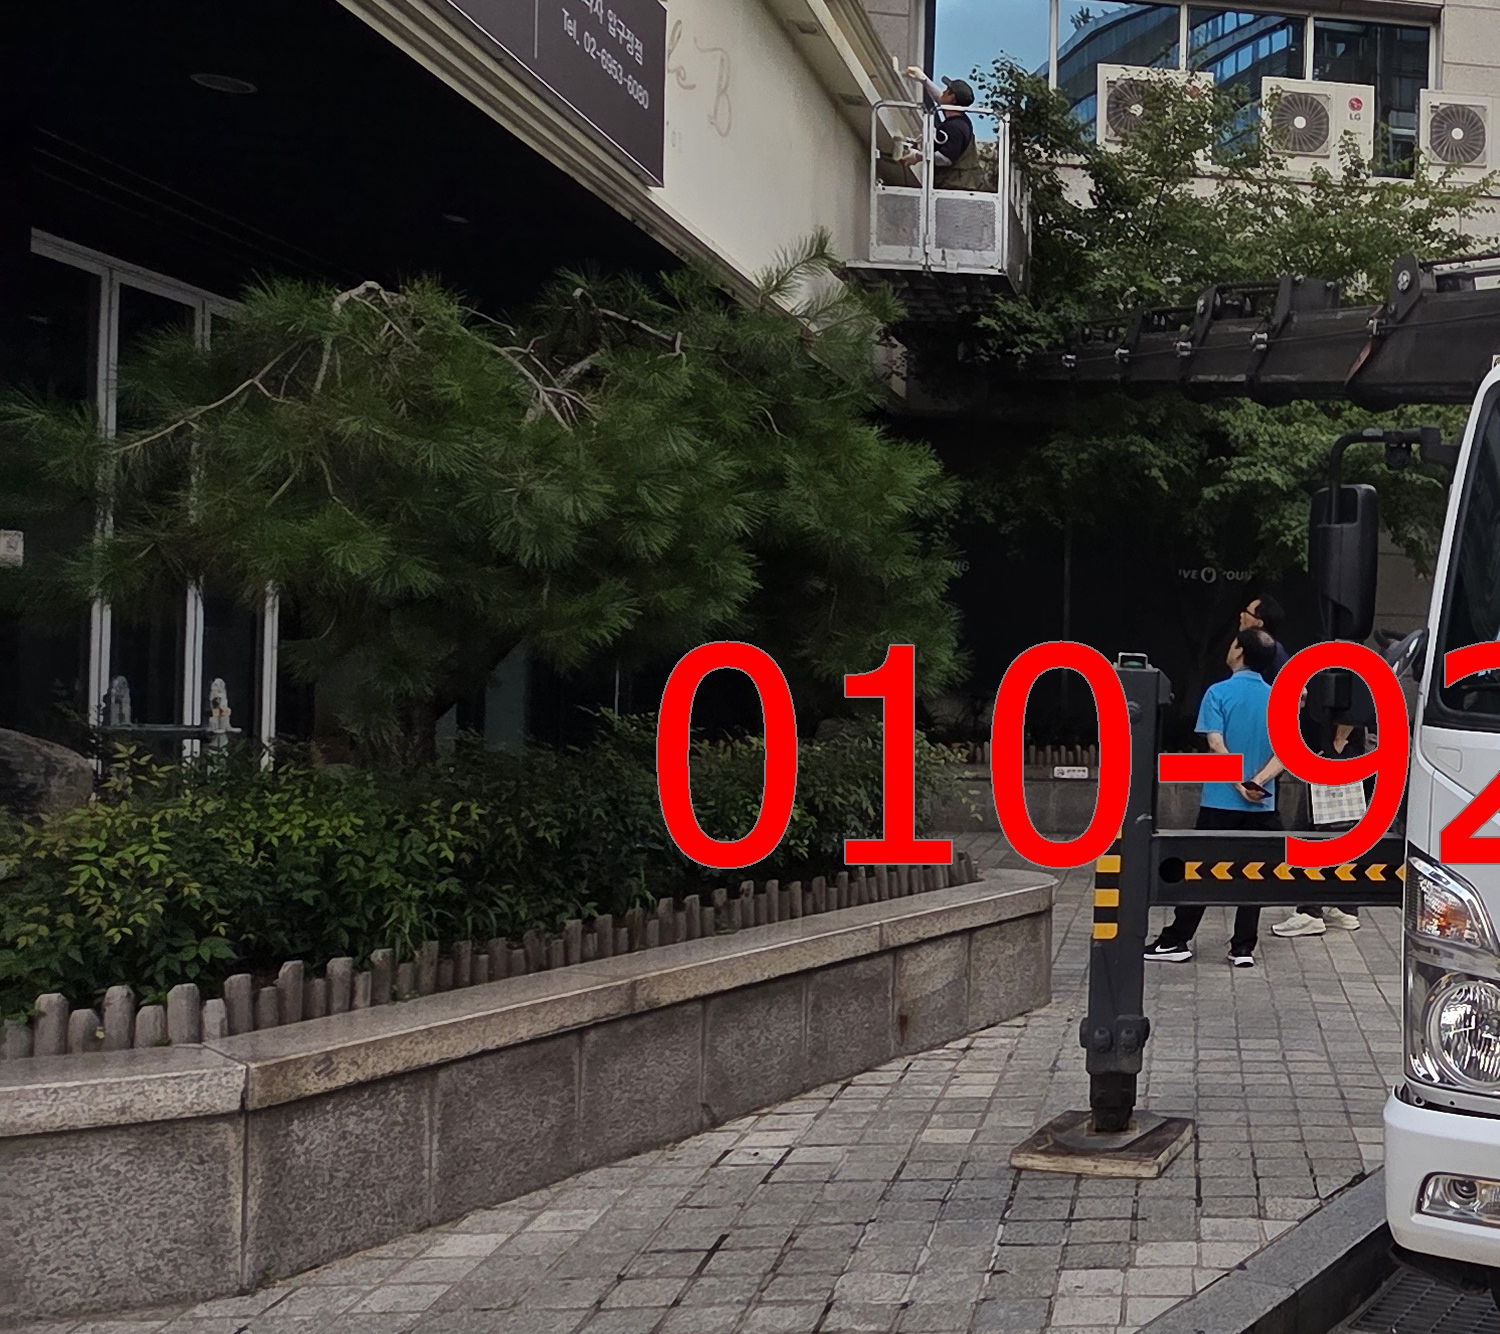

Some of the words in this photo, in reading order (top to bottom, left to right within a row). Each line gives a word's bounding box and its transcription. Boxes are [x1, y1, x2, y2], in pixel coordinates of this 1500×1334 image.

[561, 7, 580, 46] Tel.
[583, 31, 649, 110] 02-6953-6080
[607, 9, 644, 66] 압구정점
[1349, 113, 1362, 121] LG
